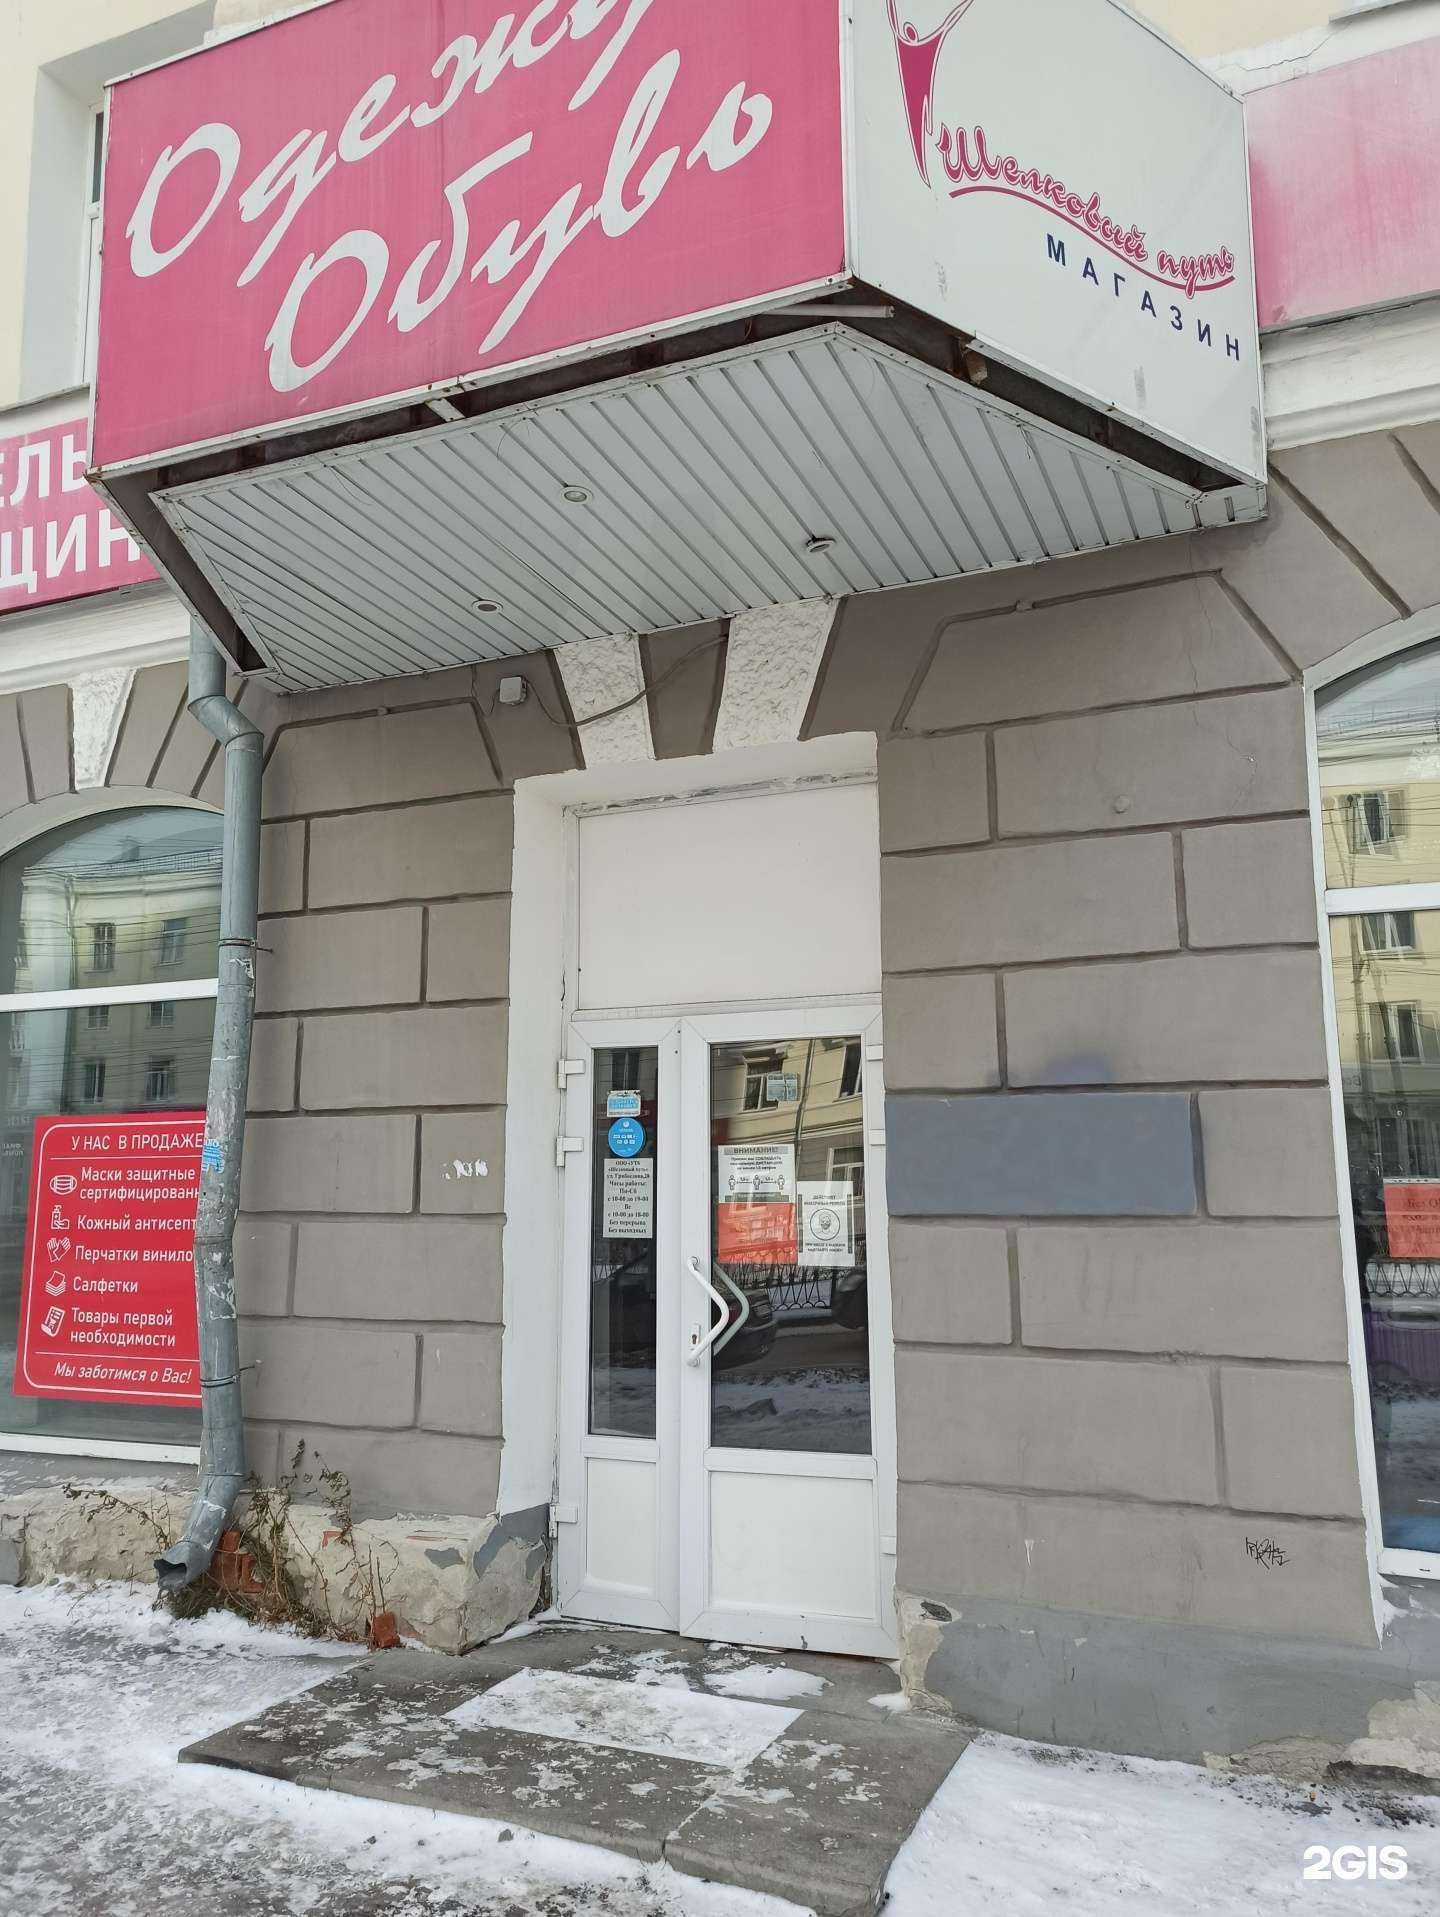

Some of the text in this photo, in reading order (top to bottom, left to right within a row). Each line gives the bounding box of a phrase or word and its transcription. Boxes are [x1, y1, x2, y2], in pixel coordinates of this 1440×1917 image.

[264, 48, 774, 393] Обувь
[935, 122, 1234, 299] Шелковый путь
[1046, 233, 1240, 361] МАГАЗИН
[0, 433, 90, 508] ЛЬ
[71, 1132, 204, 1151] У НАС В ПРОДАЖЕ
[81, 1166, 195, 1183] Маски защитные
[77, 1214, 196, 1230] Кожный антисепт
[75, 1245, 193, 1264] Перчатки винило
[73, 1276, 139, 1294] Салфетки
[72, 1307, 173, 1328] Товары первой
[70, 1329, 176, 1347] необходимости
[54, 1361, 192, 1384] Мы заботимся о Вас!
